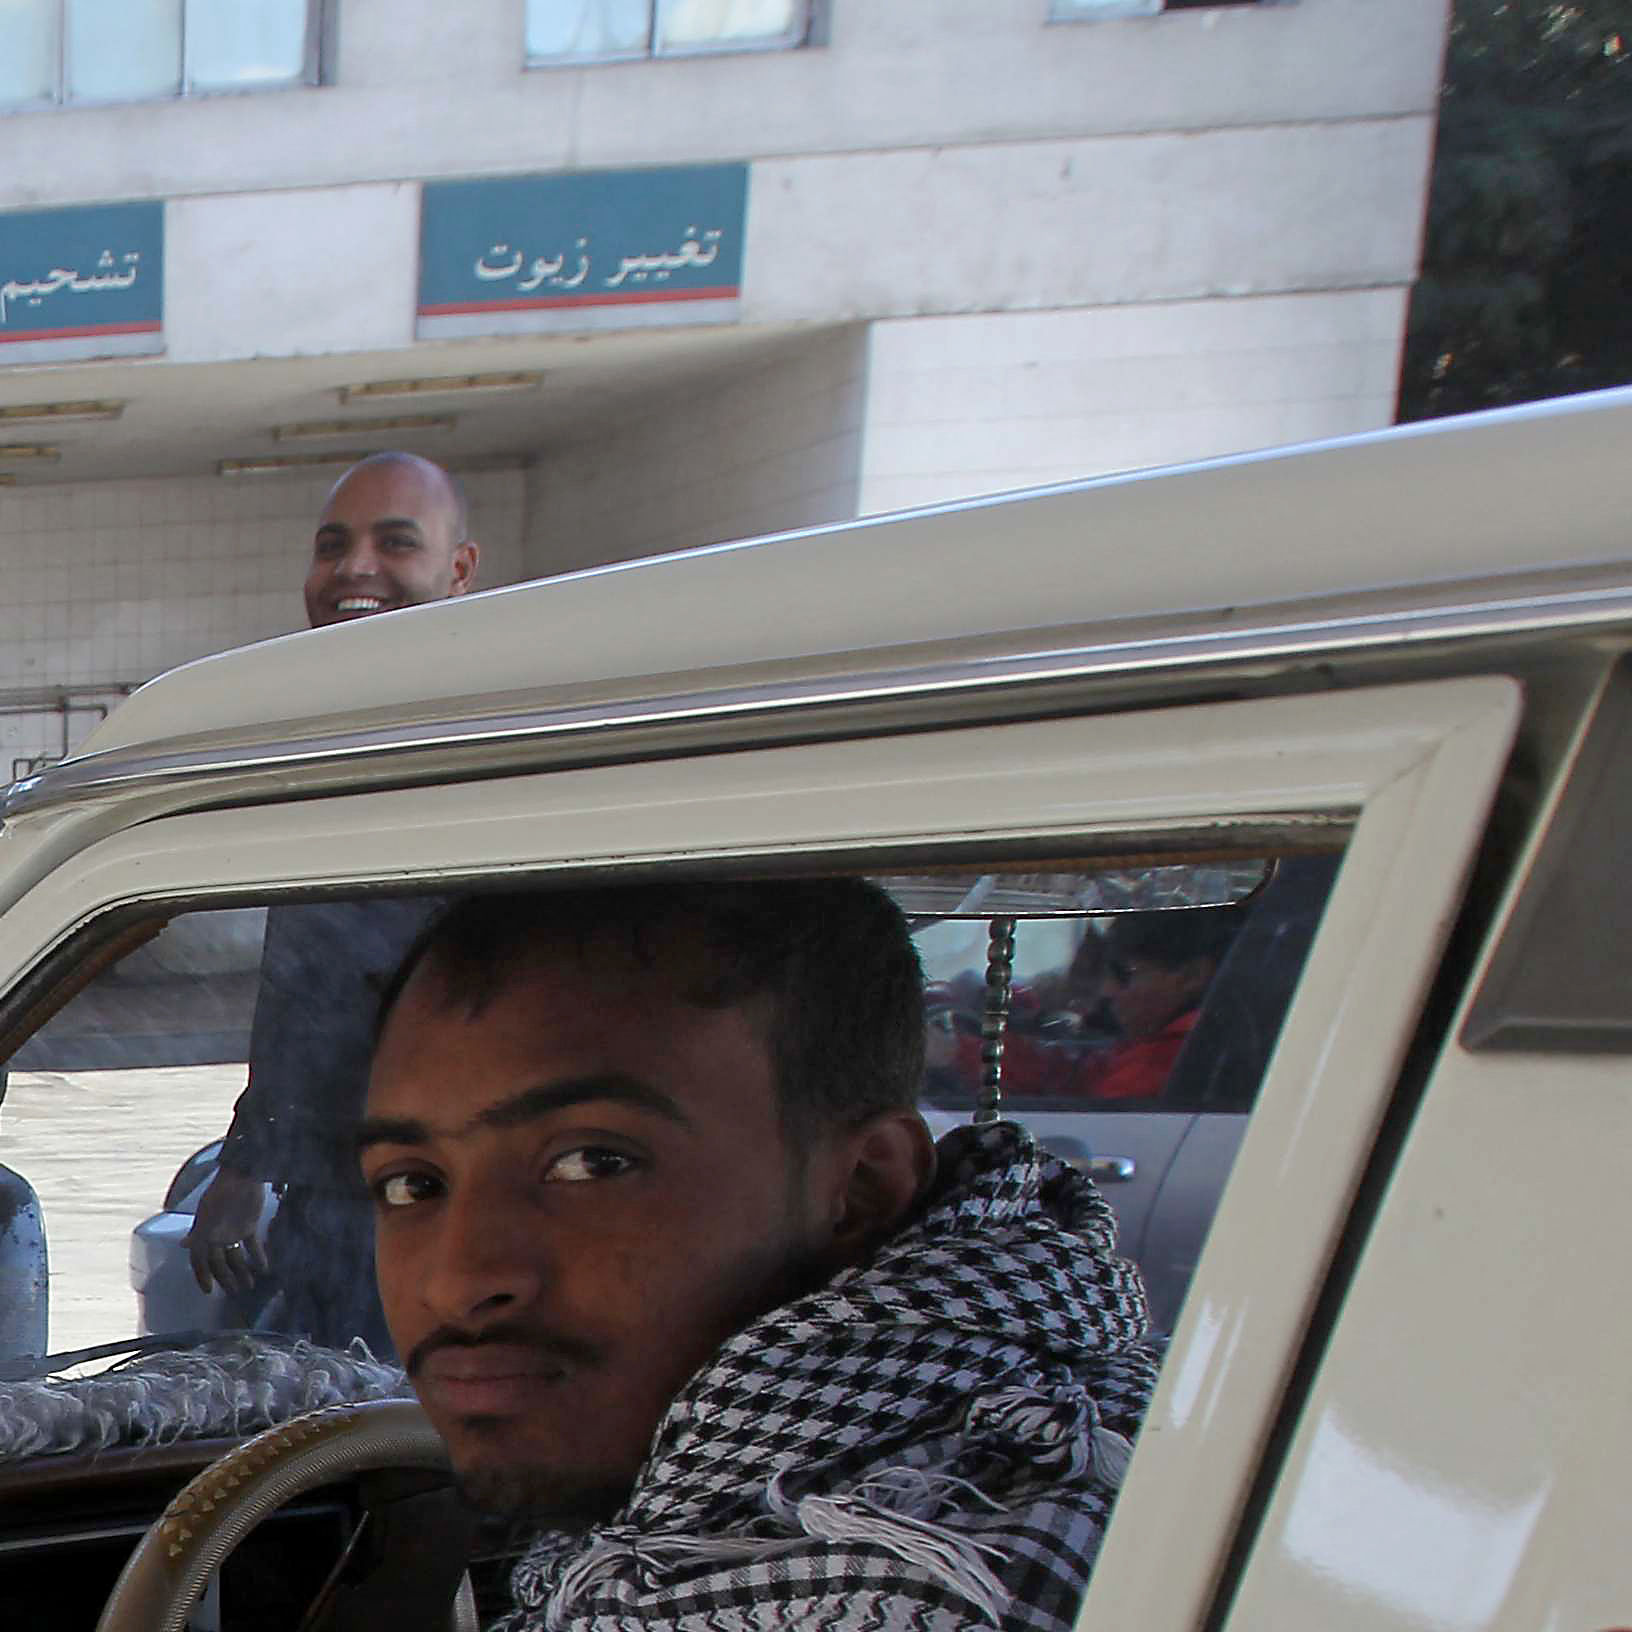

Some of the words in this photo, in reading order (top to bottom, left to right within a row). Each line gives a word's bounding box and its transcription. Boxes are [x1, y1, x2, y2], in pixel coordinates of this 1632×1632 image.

[0, 249, 140, 323] تشحيم
[474, 236, 589, 290] زيوت
[605, 224, 723, 287] تغيير
